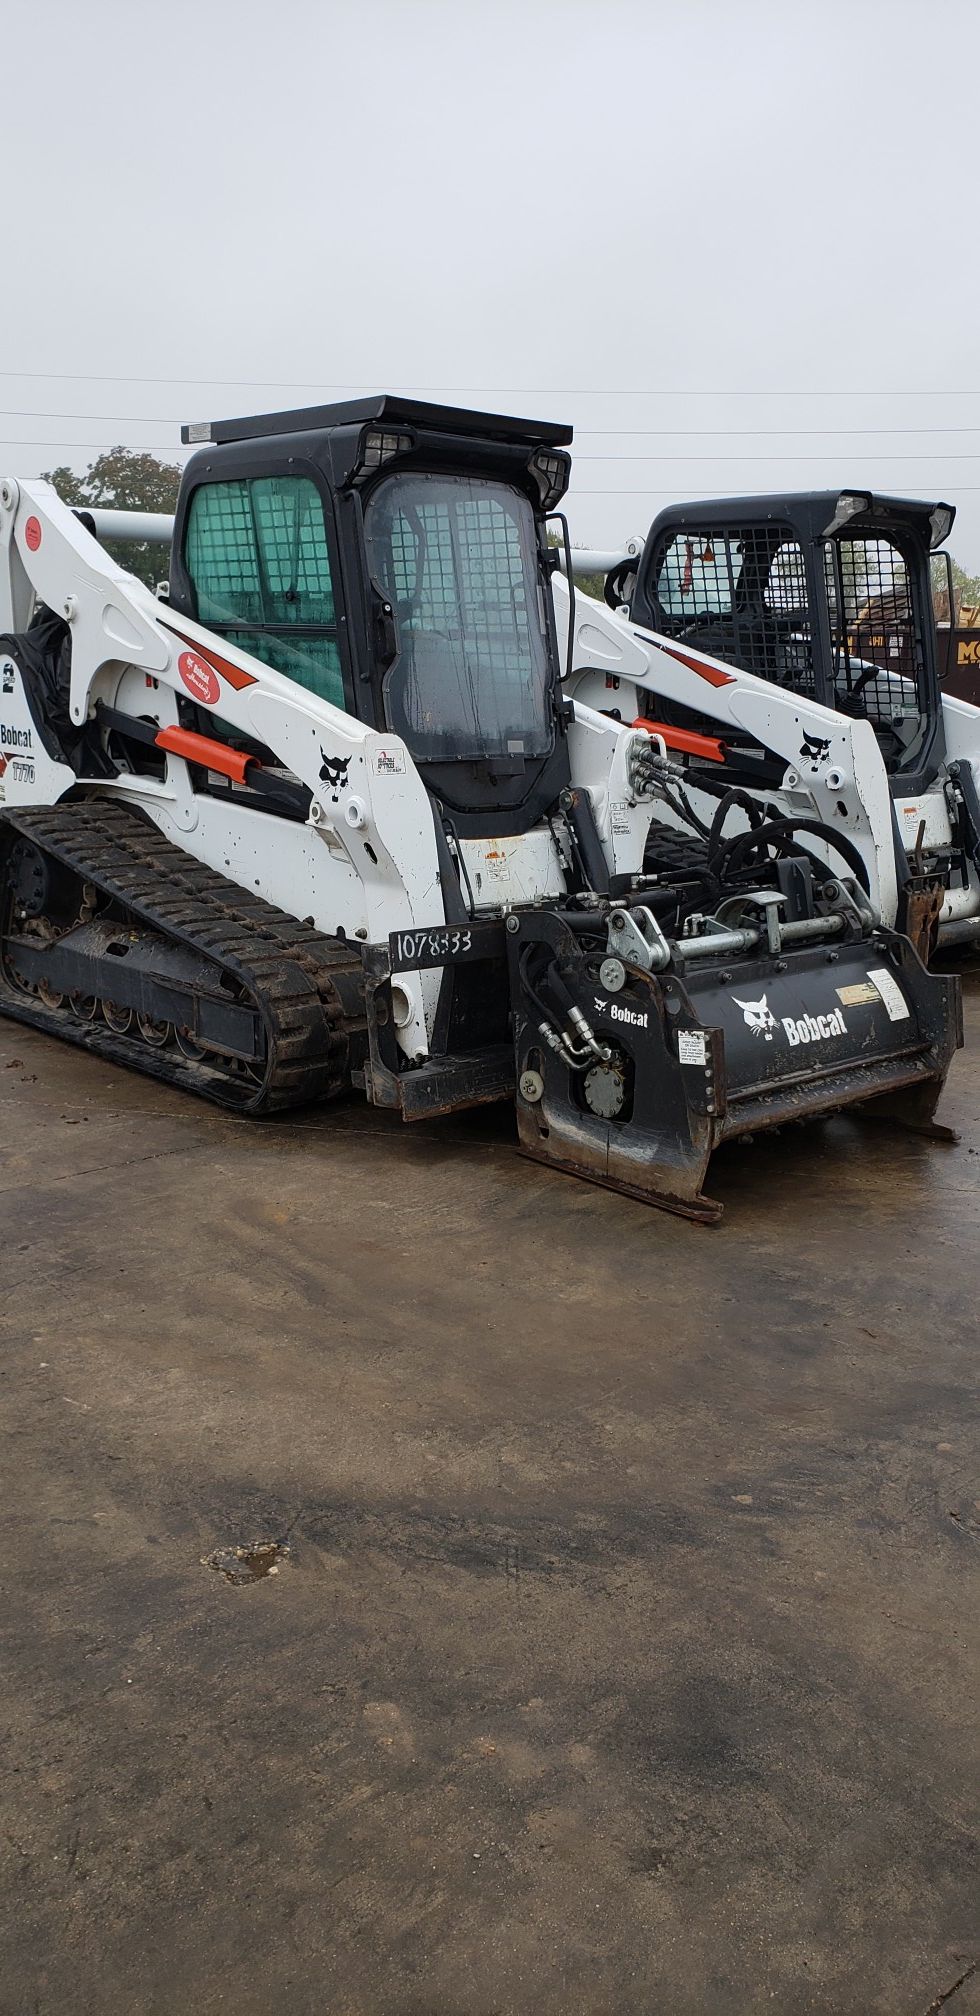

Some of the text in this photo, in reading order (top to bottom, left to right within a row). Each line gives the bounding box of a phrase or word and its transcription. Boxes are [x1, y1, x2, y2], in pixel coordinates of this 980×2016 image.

[0, 724, 32, 748] Bobcat
[12, 761, 36, 784] T770
[397, 930, 472, 961] 1078333
[610, 1004, 648, 1029] Bobcat
[781, 1007, 848, 1047] Bobcat
